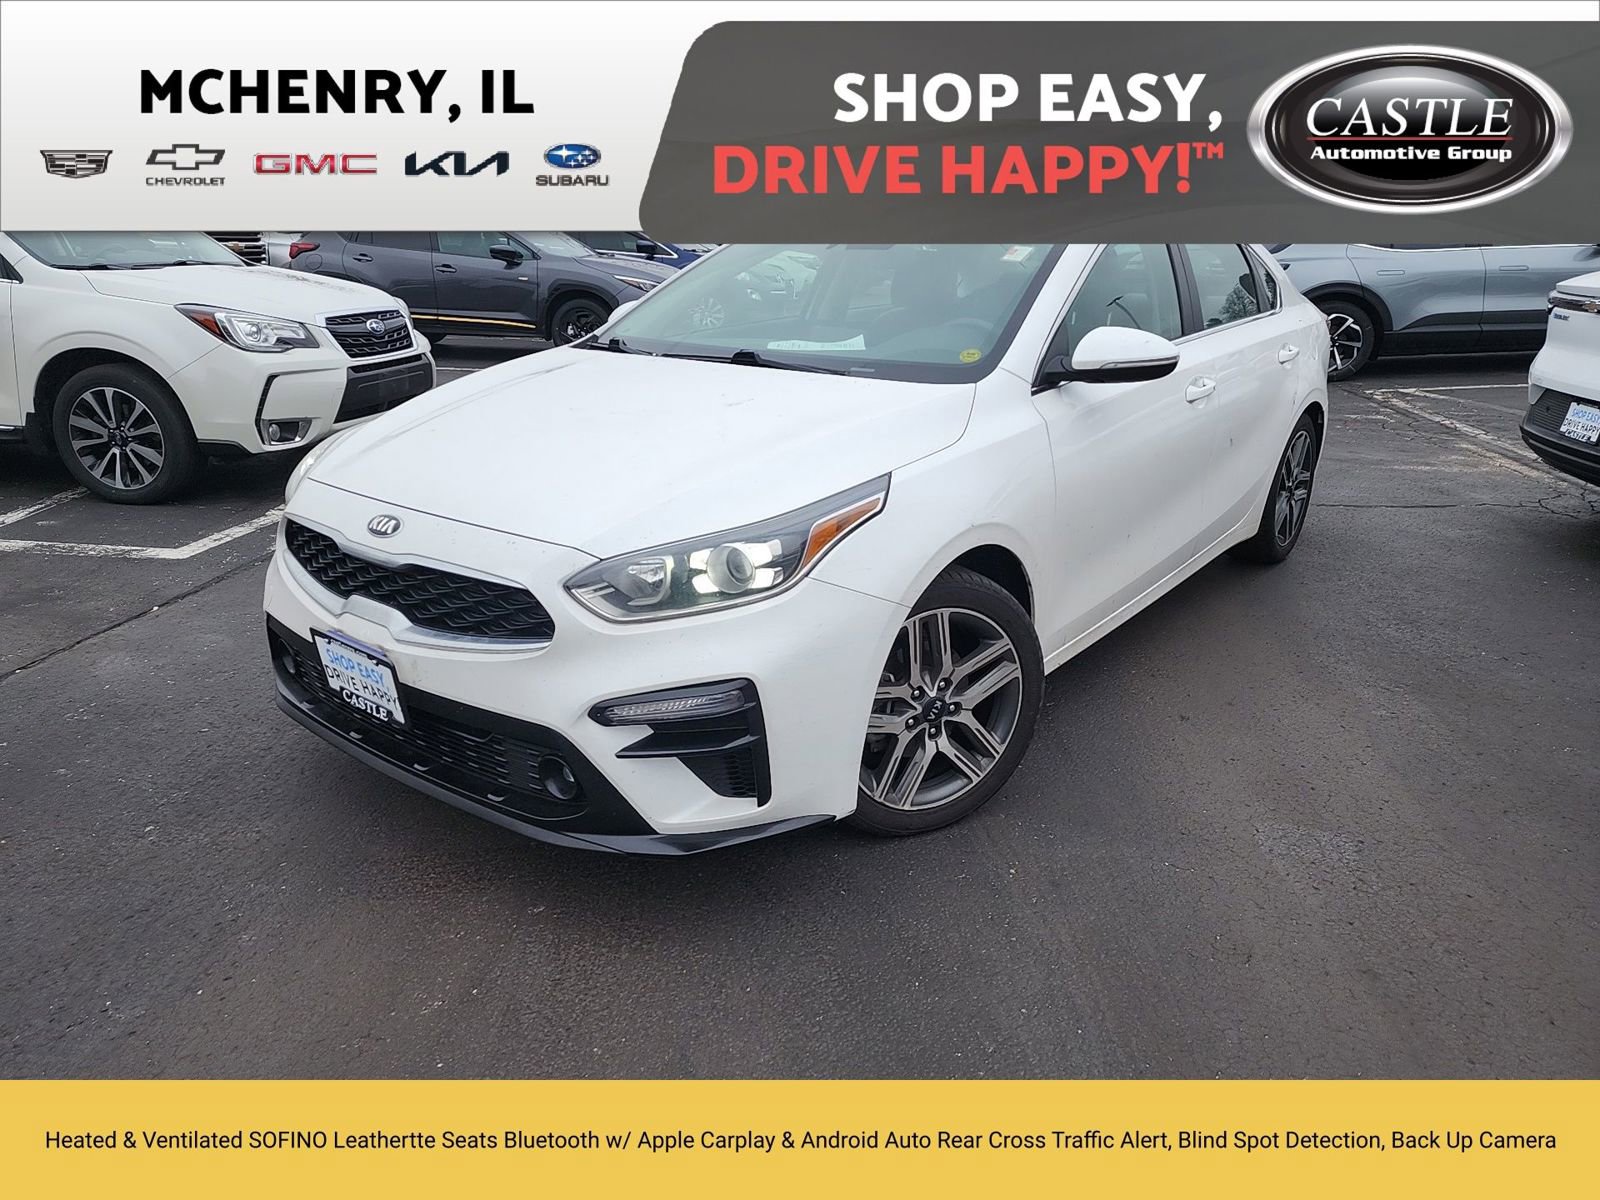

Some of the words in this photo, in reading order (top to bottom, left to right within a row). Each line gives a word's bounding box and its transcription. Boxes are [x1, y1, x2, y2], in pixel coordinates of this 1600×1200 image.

[369, 516, 397, 534] KIA
[326, 648, 355, 673] SHOP
[324, 664, 359, 692] DRIVE
[360, 681, 398, 712] HAPPY
[342, 689, 389, 722] CASTLE
[927, 700, 942, 719] KIA
